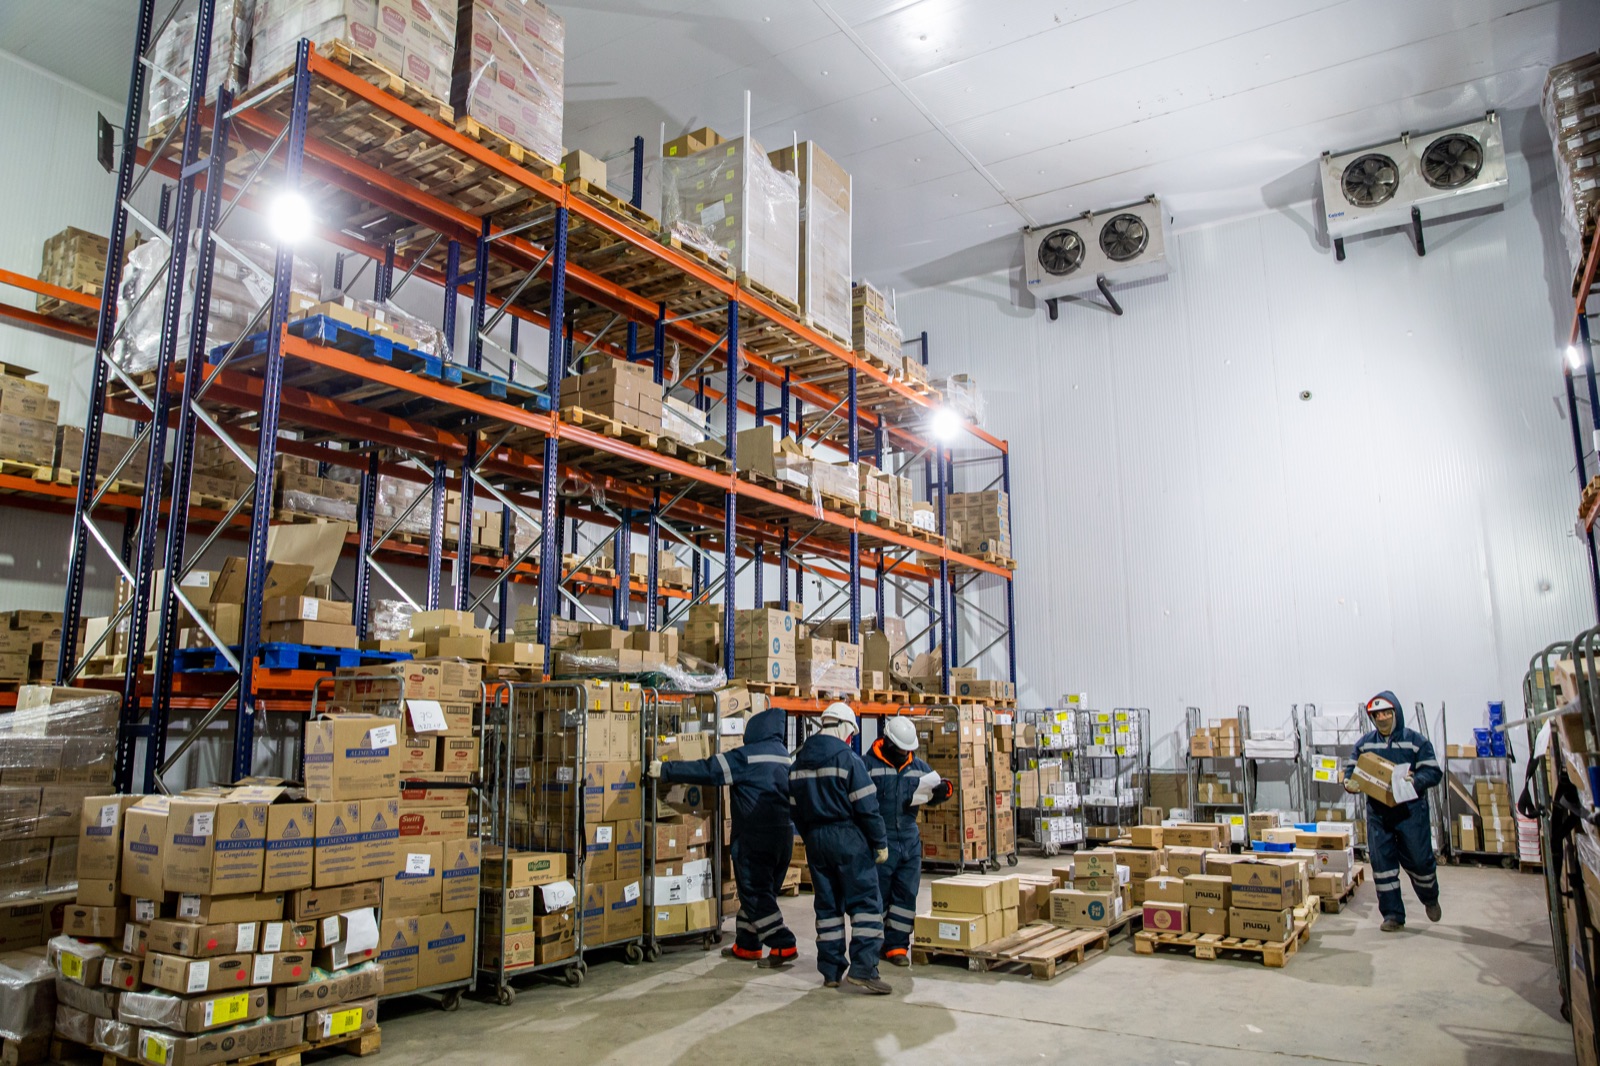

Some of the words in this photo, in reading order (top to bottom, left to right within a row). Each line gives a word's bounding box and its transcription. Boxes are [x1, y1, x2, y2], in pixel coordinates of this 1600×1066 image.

[349, 749, 386, 757] ALIMENTOS
[402, 815, 421, 823] Swift
[360, 831, 398, 840] ALIMENTOS
[216, 840, 263, 849] ALIMENTOS
[269, 839, 312, 849] ALIMENTOS
[319, 836, 358, 845] ALIMENTOS
[446, 868, 478, 877] ALIMENTOS
[1195, 891, 1221, 901] franui
[1243, 921, 1271, 932] franui
[431, 936, 463, 947] ALIMENTOS
[381, 948, 418, 958] ALIMENTOS
